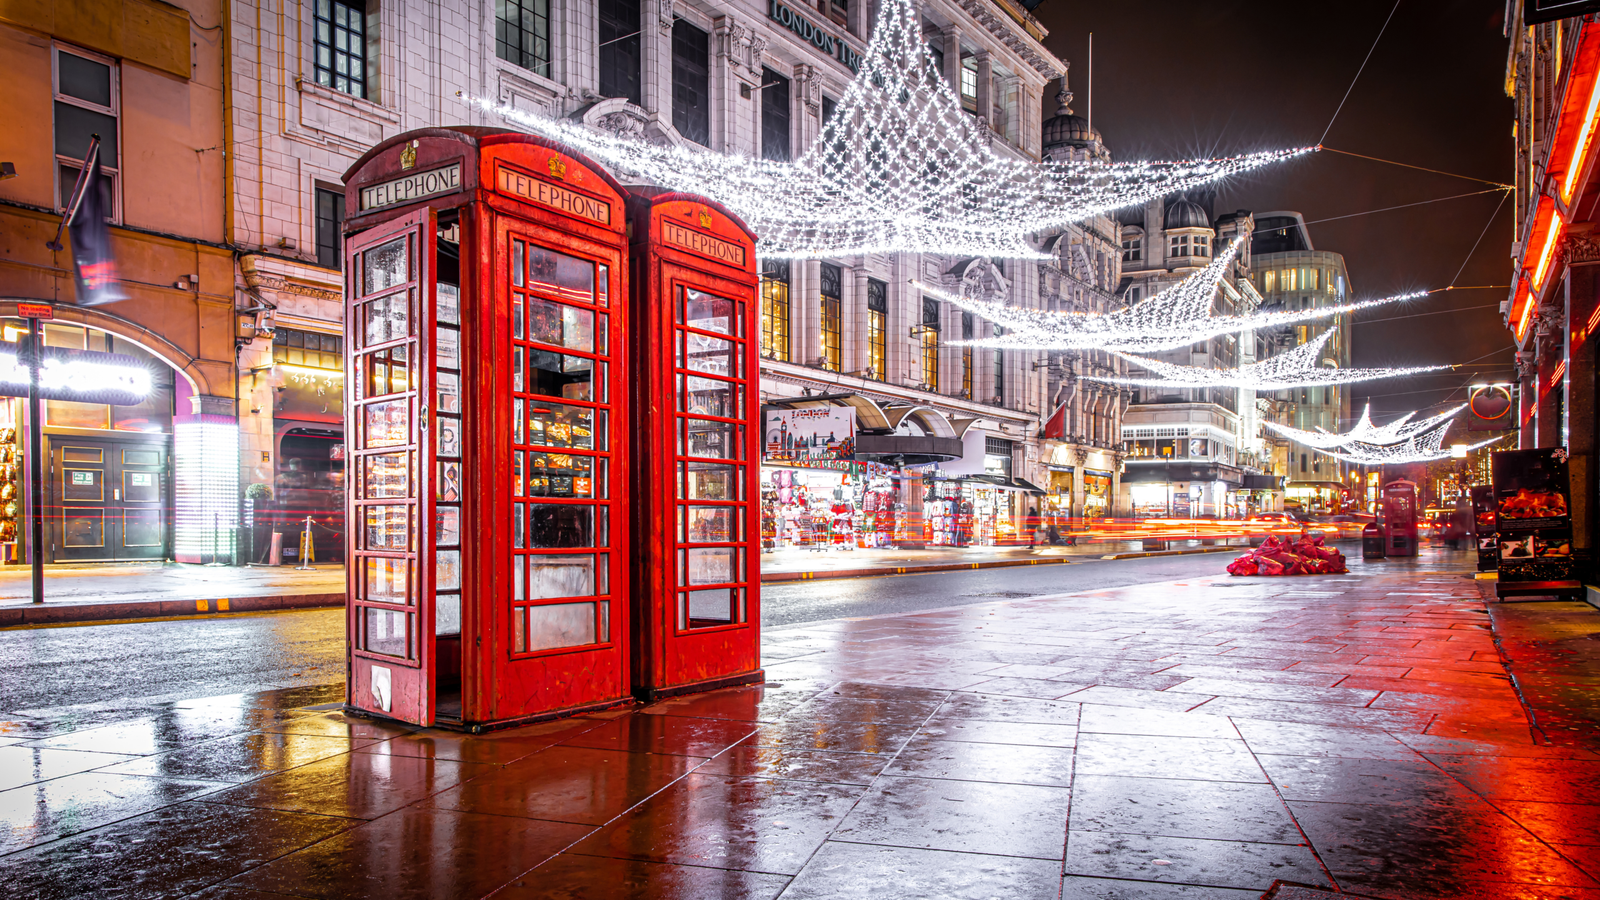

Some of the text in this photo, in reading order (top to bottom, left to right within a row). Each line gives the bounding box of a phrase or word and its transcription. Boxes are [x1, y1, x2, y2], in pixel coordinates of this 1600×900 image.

[772, 0, 835, 54] LONDON
[365, 166, 459, 207] TELEPHONE
[501, 169, 605, 222] TELEPHONE
[666, 224, 741, 263] TELEPHONE
[262, 451, 270, 462] H
